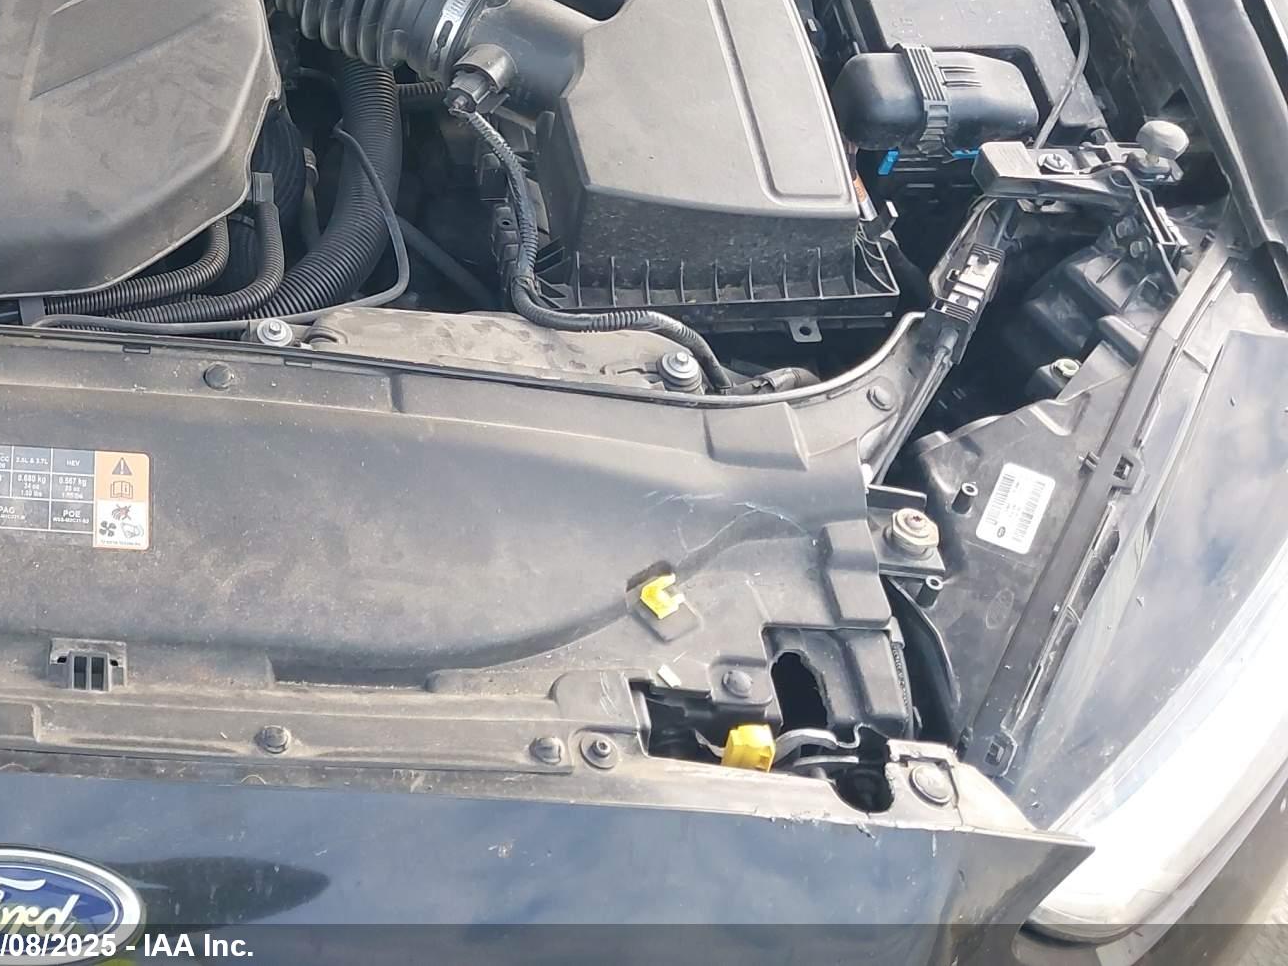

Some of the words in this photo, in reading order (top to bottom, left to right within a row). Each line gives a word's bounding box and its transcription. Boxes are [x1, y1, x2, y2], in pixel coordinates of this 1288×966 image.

[37, 474, 47, 484] kg
[78, 478, 87, 487] kg
[63, 509, 82, 518] POE
